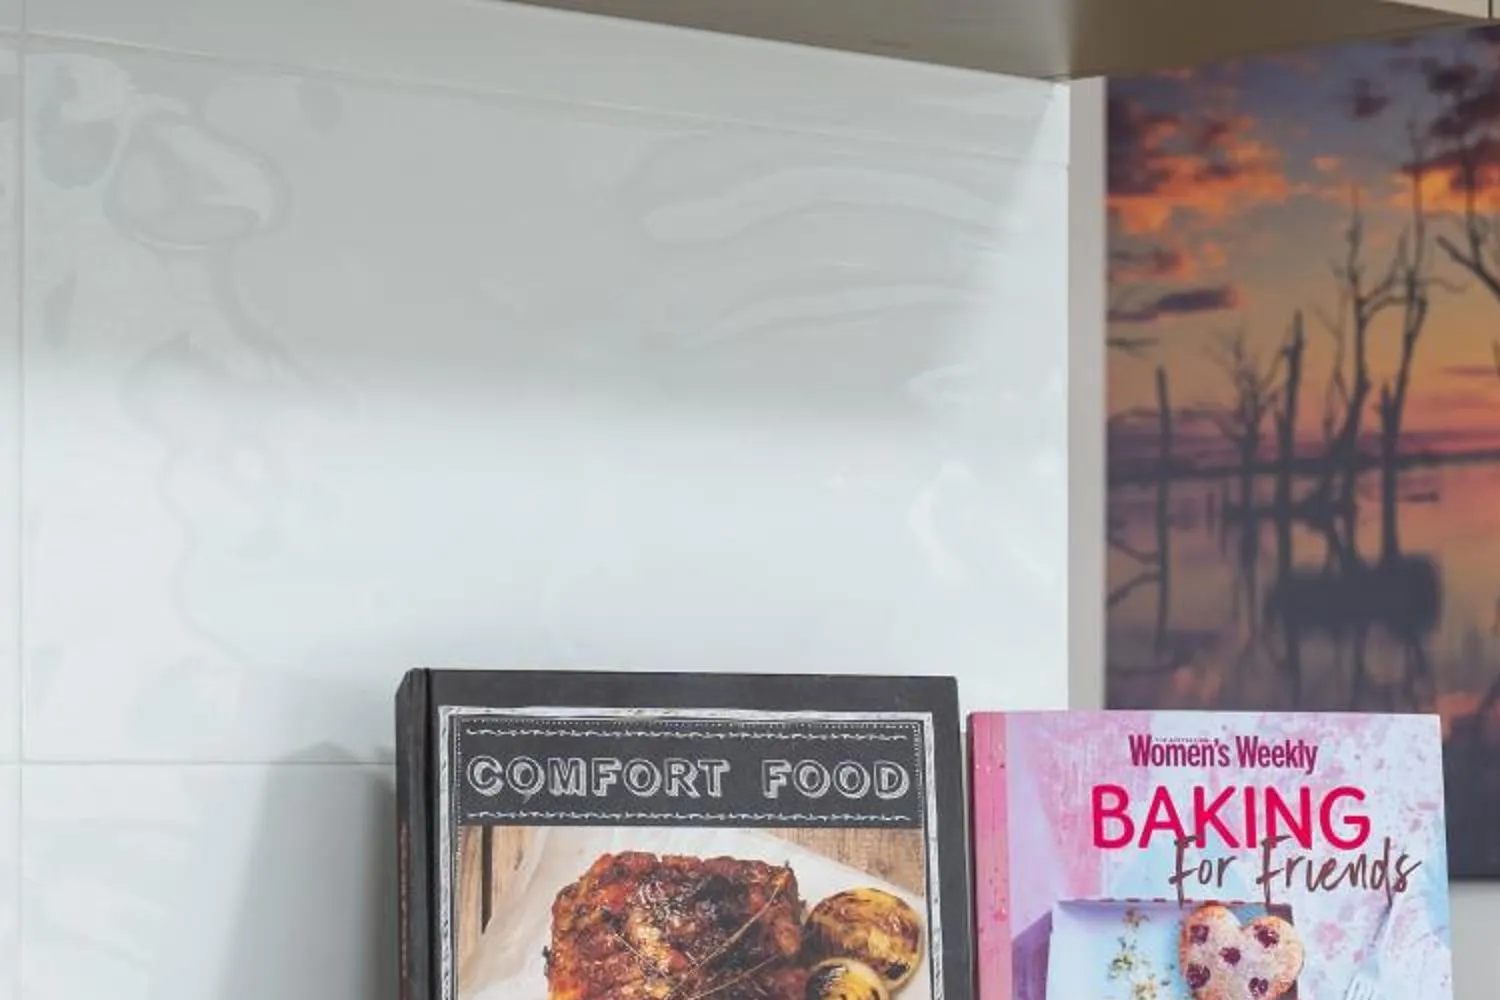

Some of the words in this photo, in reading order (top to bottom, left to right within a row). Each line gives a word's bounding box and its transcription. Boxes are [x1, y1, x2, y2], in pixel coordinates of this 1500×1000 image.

[1128, 734, 1230, 766] Women's
[1235, 736, 1318, 774] Weekly
[466, 755, 731, 801] COMFORT
[762, 759, 910, 799] FOOD
[1091, 784, 1371, 850] BAKING
